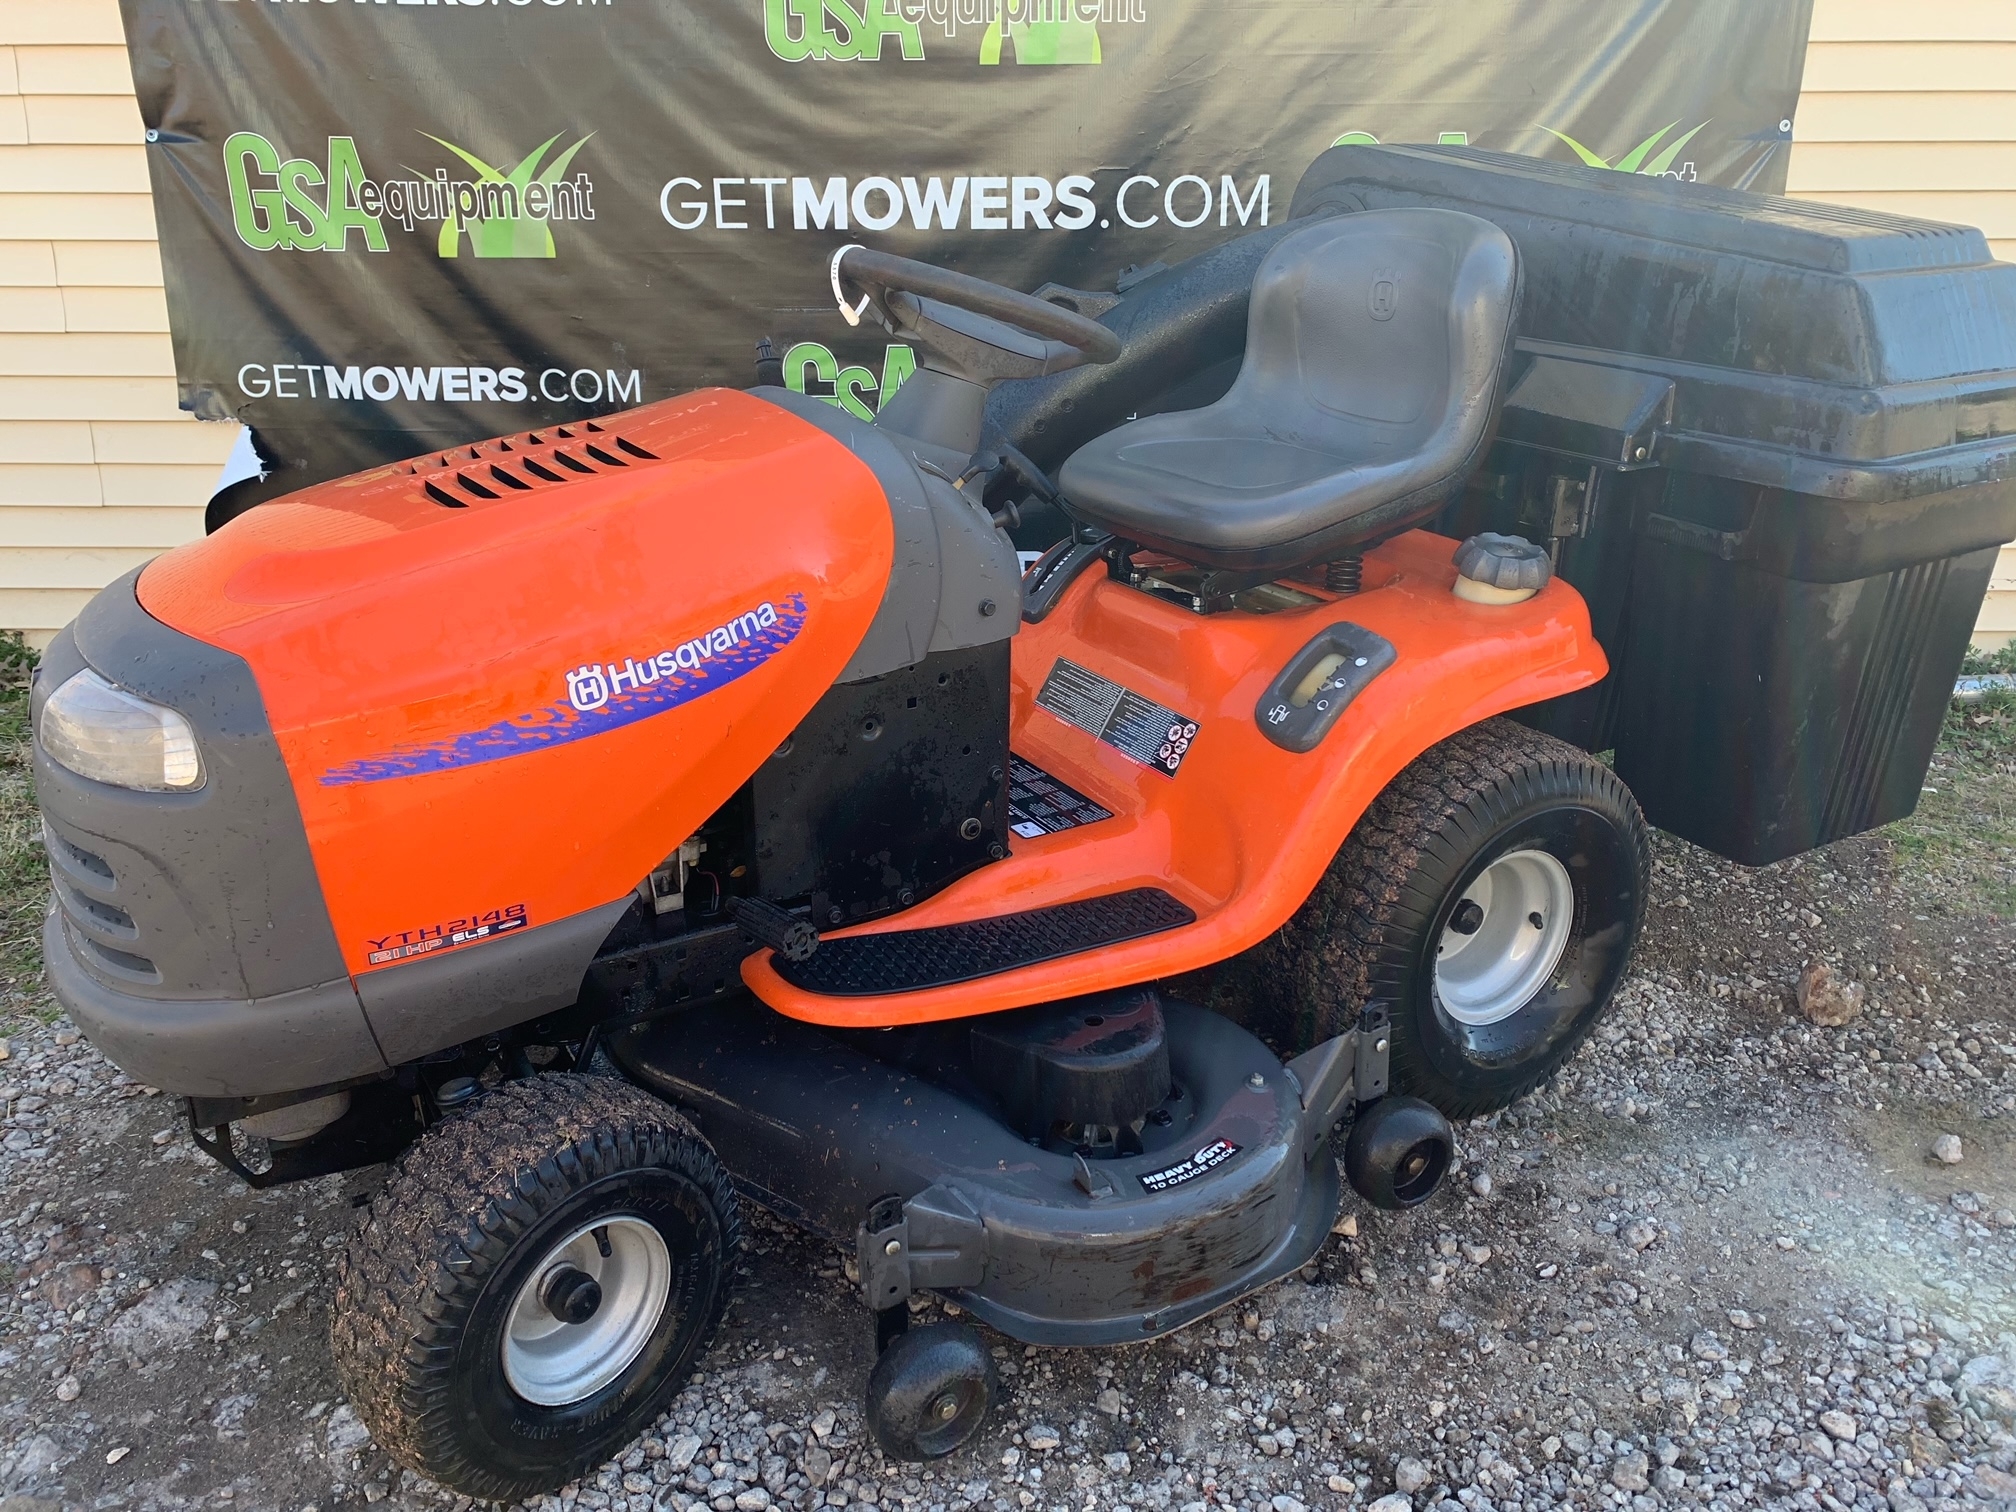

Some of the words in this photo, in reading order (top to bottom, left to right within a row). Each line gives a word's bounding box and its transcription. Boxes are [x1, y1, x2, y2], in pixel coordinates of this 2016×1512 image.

[357, 168, 595, 232] equipment
[659, 174, 1270, 231] GETMOWERS.COM
[237, 363, 642, 403] GETMOWERS.COM
[607, 602, 778, 695] Husqvarna
[367, 904, 525, 949] YTH2148
[374, 948, 400, 963] 21
[406, 938, 443, 955] HP
[452, 926, 490, 942] ELS
[1142, 1161, 1194, 1185] HEAVY
[1194, 1141, 1227, 1165] DUTY
[1150, 1181, 1167, 1190] 10
[1209, 1147, 1237, 1167] DECK
